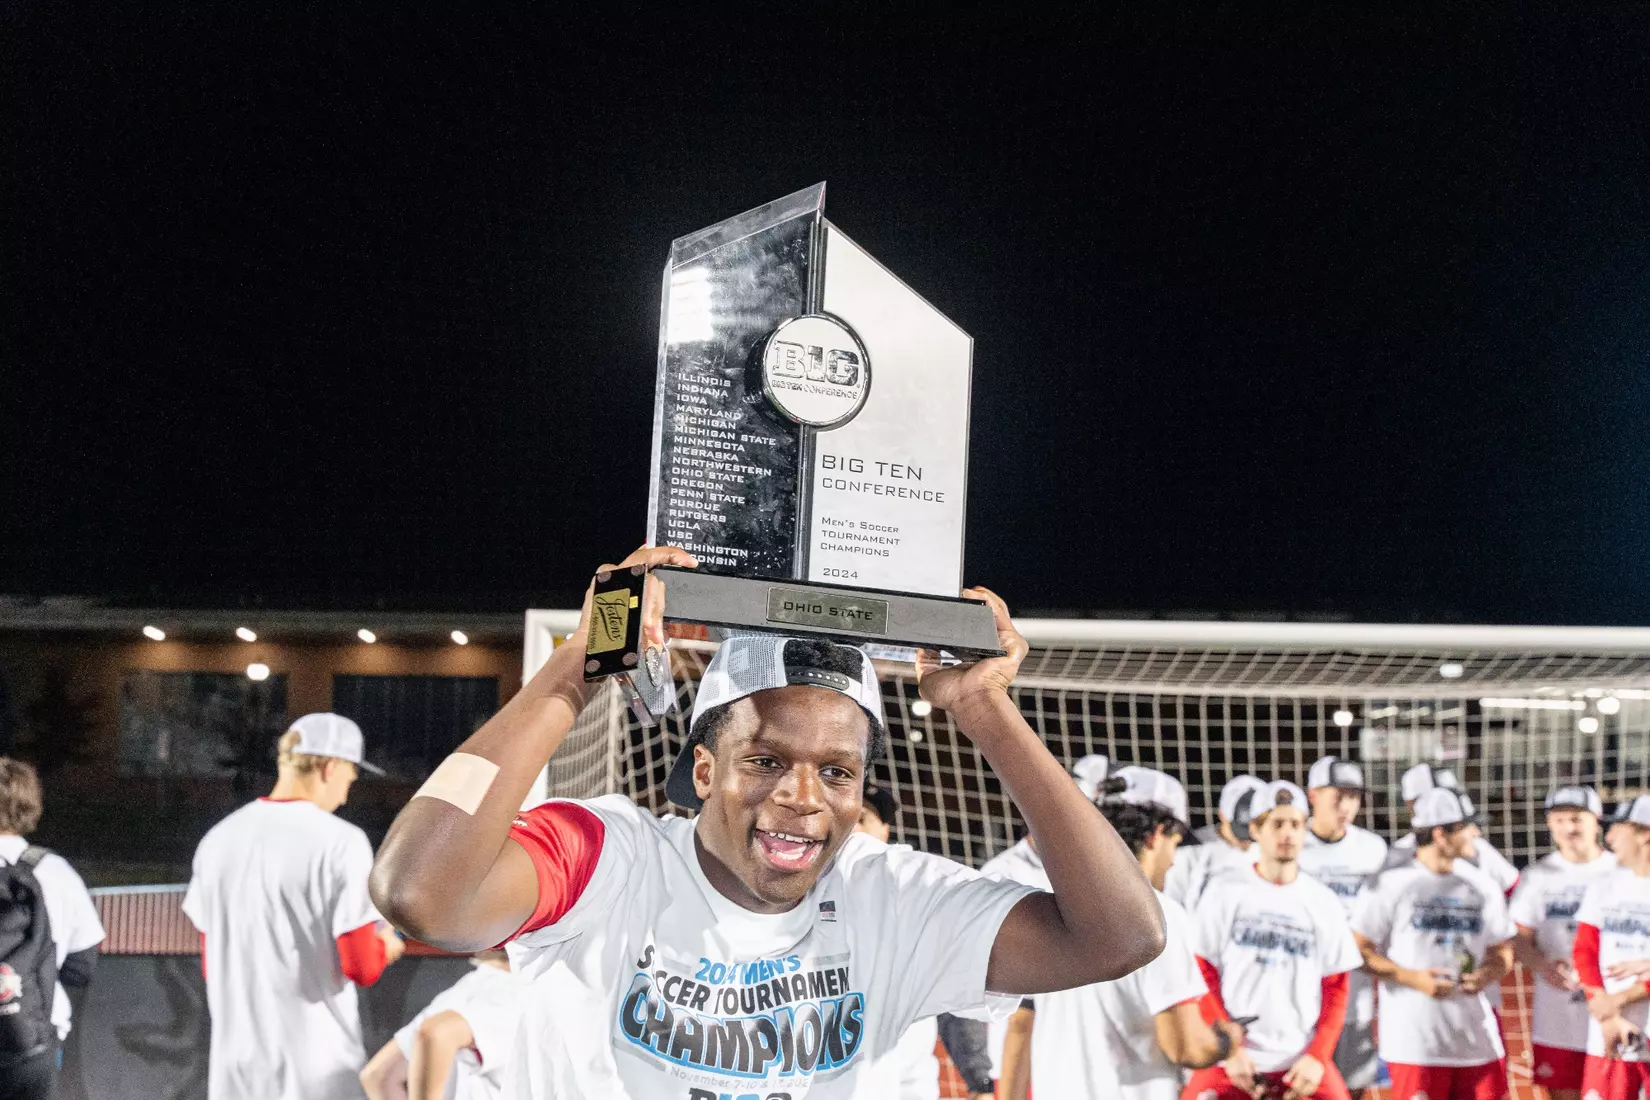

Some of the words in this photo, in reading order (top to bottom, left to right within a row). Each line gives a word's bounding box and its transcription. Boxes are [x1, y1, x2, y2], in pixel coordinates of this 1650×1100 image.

[678, 373, 732, 387] ILLINOIS
[677, 383, 729, 397] INDIANA
[676, 393, 708, 405] IOWA
[676, 404, 742, 420] MARYLAND
[675, 414, 736, 430] MICHIGAN
[674, 424, 736, 440] MICHIGAN
[741, 433, 776, 446] STATE
[674, 436, 745, 452] MINNESOTA
[673, 446, 739, 462] NEBRASKA
[672, 456, 772, 476] NORTHWESTERN
[822, 454, 864, 473] BIG
[875, 461, 922, 481] TEN
[672, 467, 703, 478] OHIO
[709, 471, 745, 483] STATE
[671, 477, 724, 491] OREGON
[822, 477, 945, 503] CONFERENCE
[670, 487, 704, 499] PENN
[709, 491, 745, 504] STATE
[670, 498, 721, 512] PURDUE
[669, 509, 727, 523] RUTGERS
[668, 519, 701, 530] UCLA
[667, 530, 693, 539] USC
[821, 529, 900, 546] TOURNAMENT
[666, 540, 749, 558] WASHINGTON
[820, 542, 890, 557] CHAMPIONS
[823, 567, 859, 580] 2024
[783, 601, 822, 614] OHIO
[828, 607, 874, 620] STATE
[695, 957, 740, 985] 204
[740, 954, 801, 985] MEN'S
[637, 944, 711, 1012] SCCER
[619, 972, 865, 1079] CHAMPIONS
[670, 1065, 729, 1087] November
